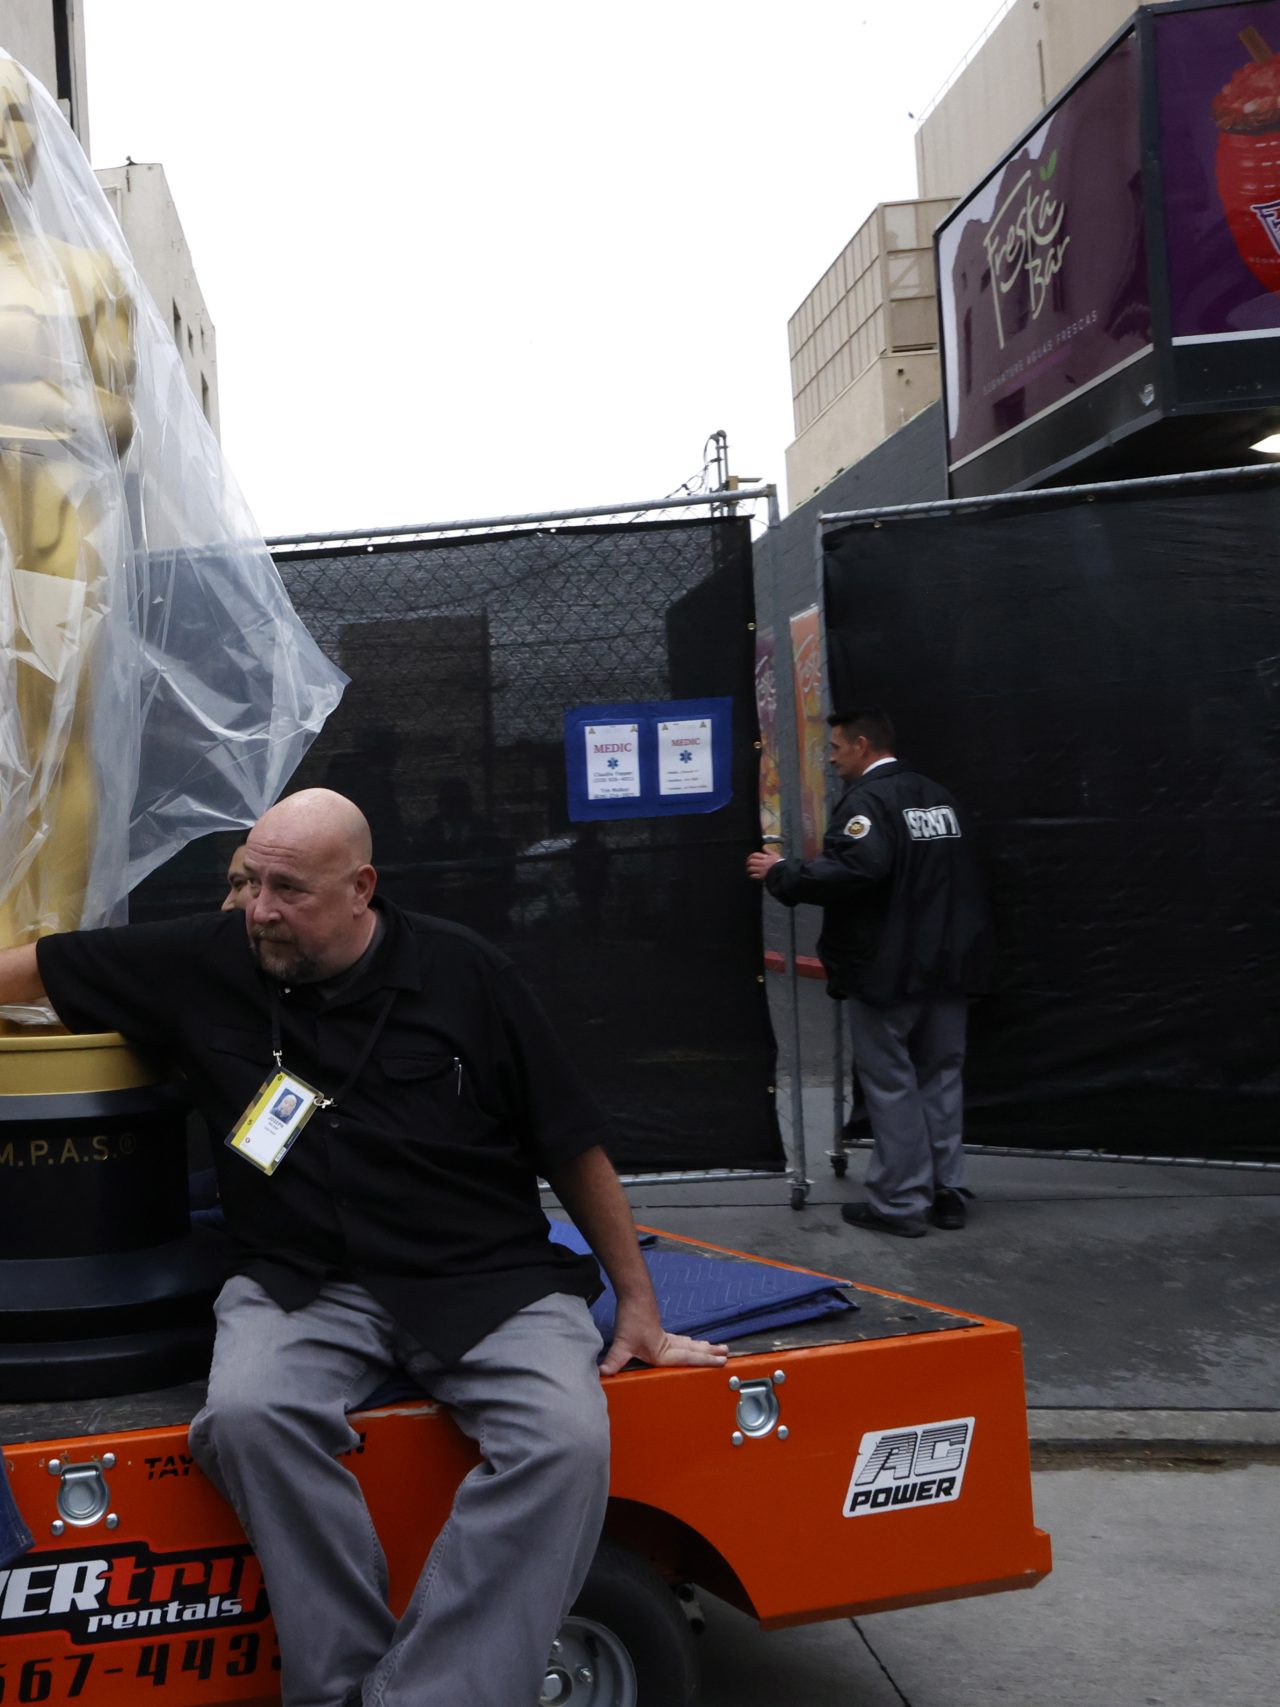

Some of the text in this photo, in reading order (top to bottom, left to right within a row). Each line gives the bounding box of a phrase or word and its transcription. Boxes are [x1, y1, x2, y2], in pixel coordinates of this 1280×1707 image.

[983, 170, 1065, 349] Freska
[1025, 236, 1070, 319] Bar
[593, 742, 632, 754] MEDIC
[671, 737, 701, 747] MEDIC
[855, 1422, 969, 1487] AC
[849, 1476, 957, 1512] POWER
[87, 1595, 244, 1634] rentals
